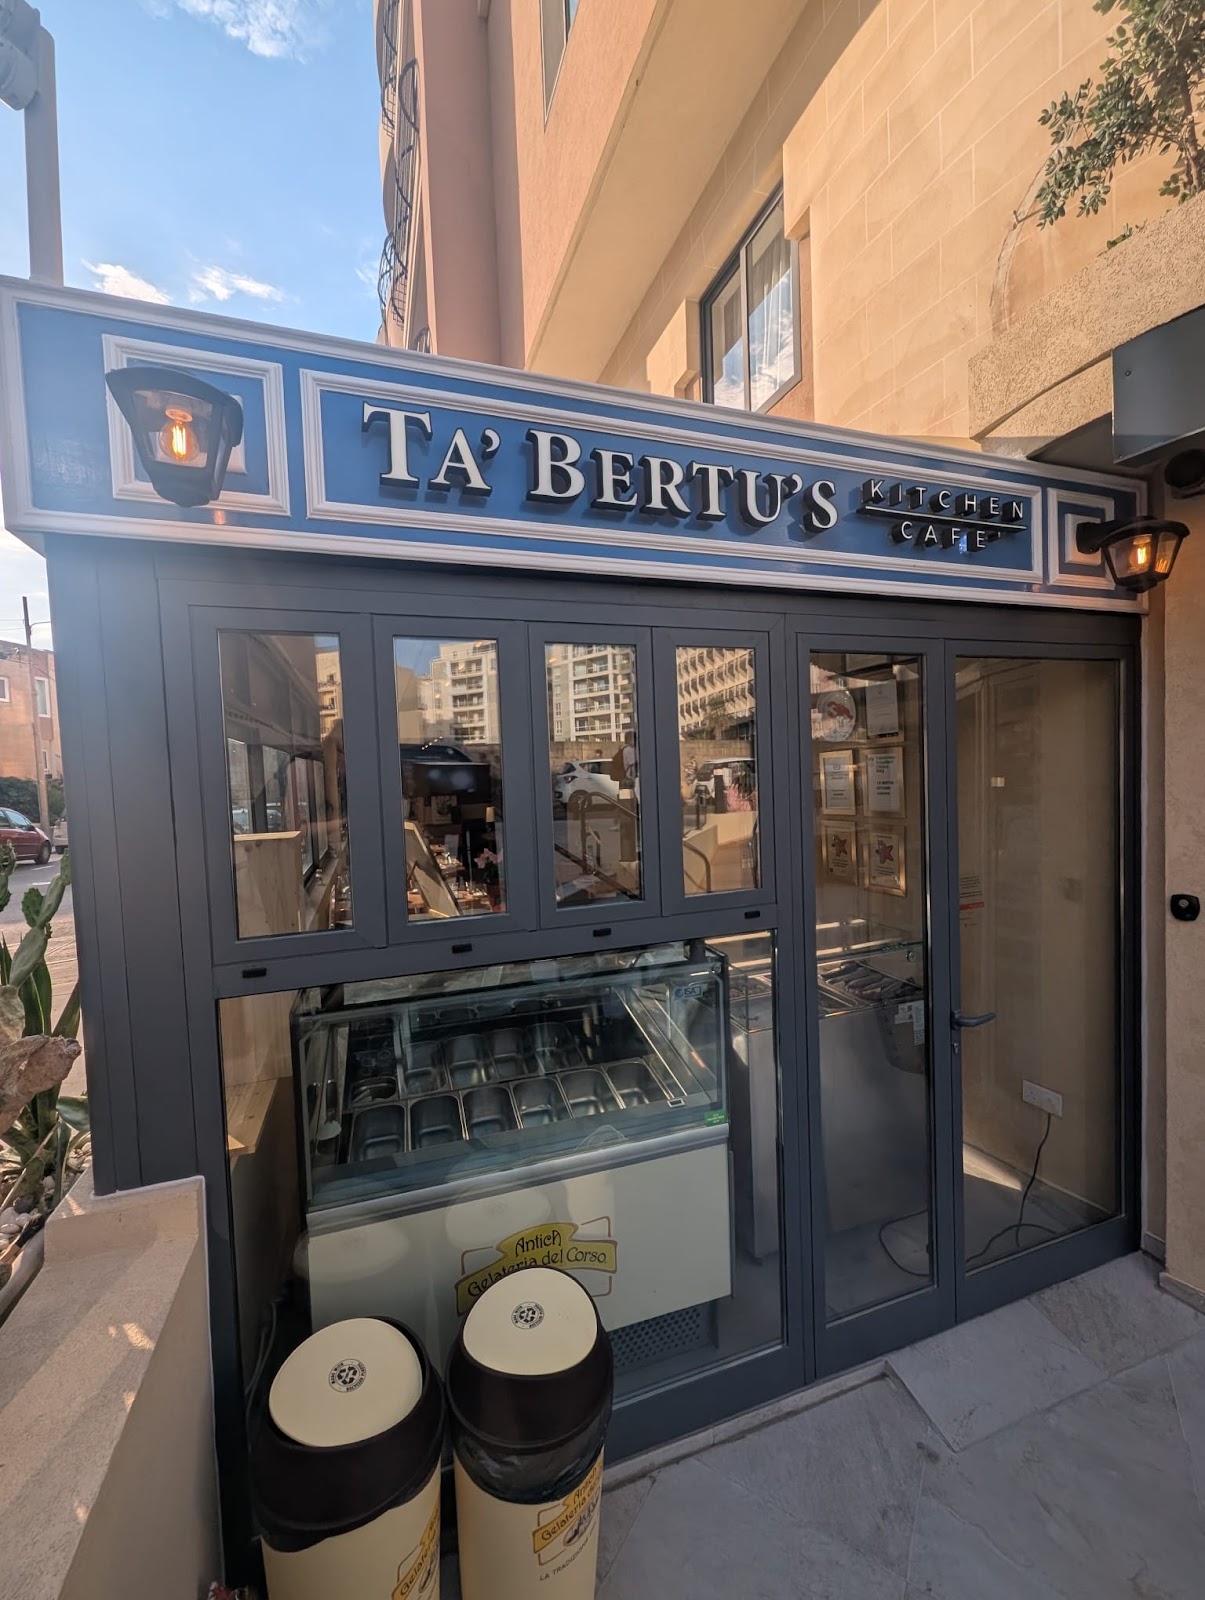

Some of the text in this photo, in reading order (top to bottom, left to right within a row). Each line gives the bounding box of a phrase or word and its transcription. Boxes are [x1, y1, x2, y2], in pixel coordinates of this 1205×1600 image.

[526, 428, 838, 533] BERTU'S
[866, 479, 1024, 521] KITCHEN
[541, 1249, 563, 1265] del
[566, 1246, 607, 1264] Corso
[540, 1572, 550, 1581] LA
